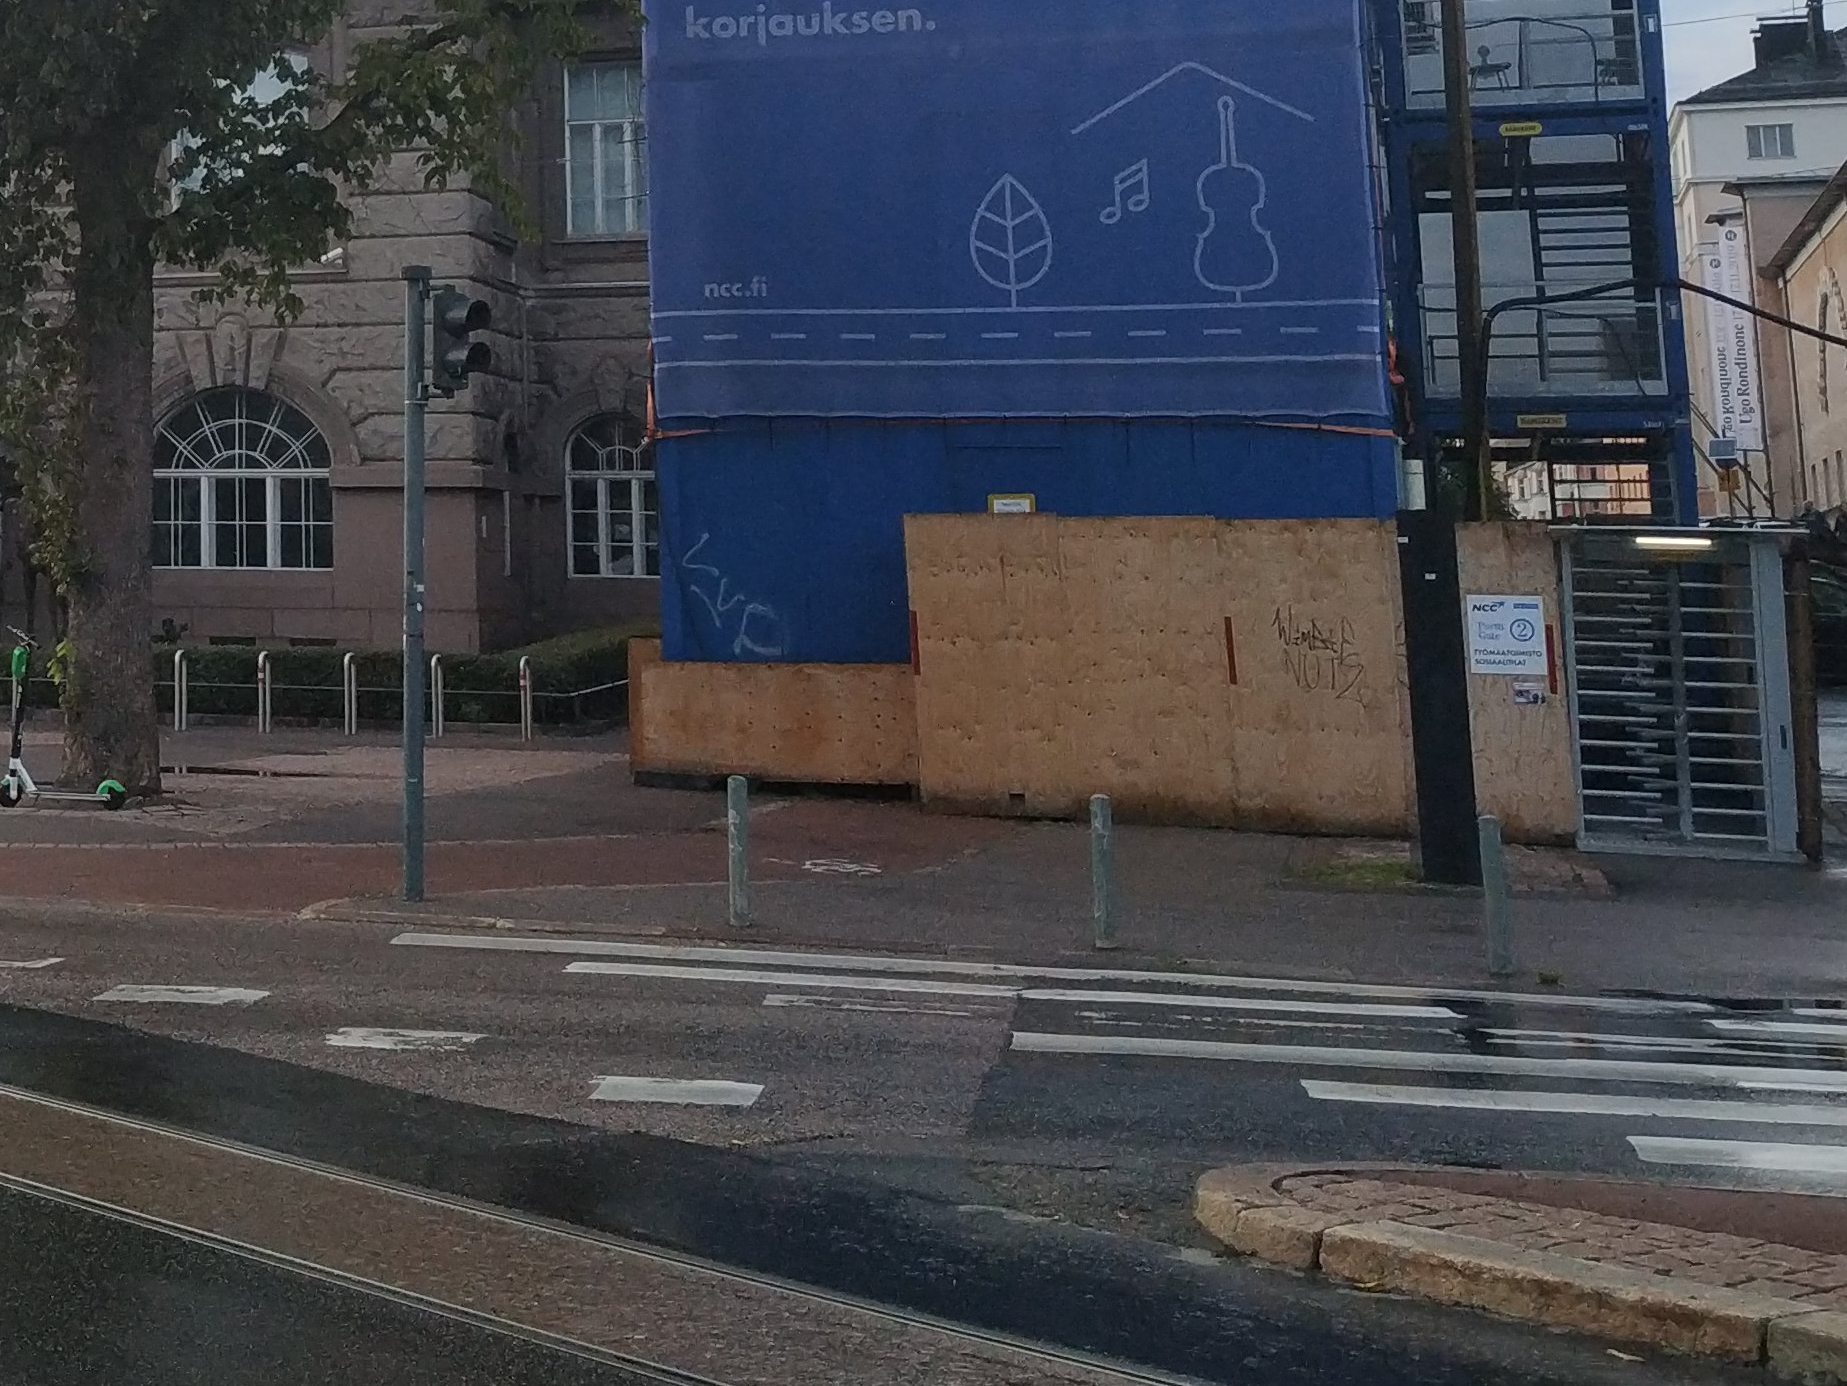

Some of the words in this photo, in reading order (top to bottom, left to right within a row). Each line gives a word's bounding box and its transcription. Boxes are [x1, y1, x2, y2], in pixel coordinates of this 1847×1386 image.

[685, 0, 936, 46] korjauksen.
[703, 275, 767, 298] ncc.fi
[1734, 324, 1751, 397] Rondinone
[1739, 398, 1755, 424] Ugo
[1472, 604, 1499, 612] NCC
